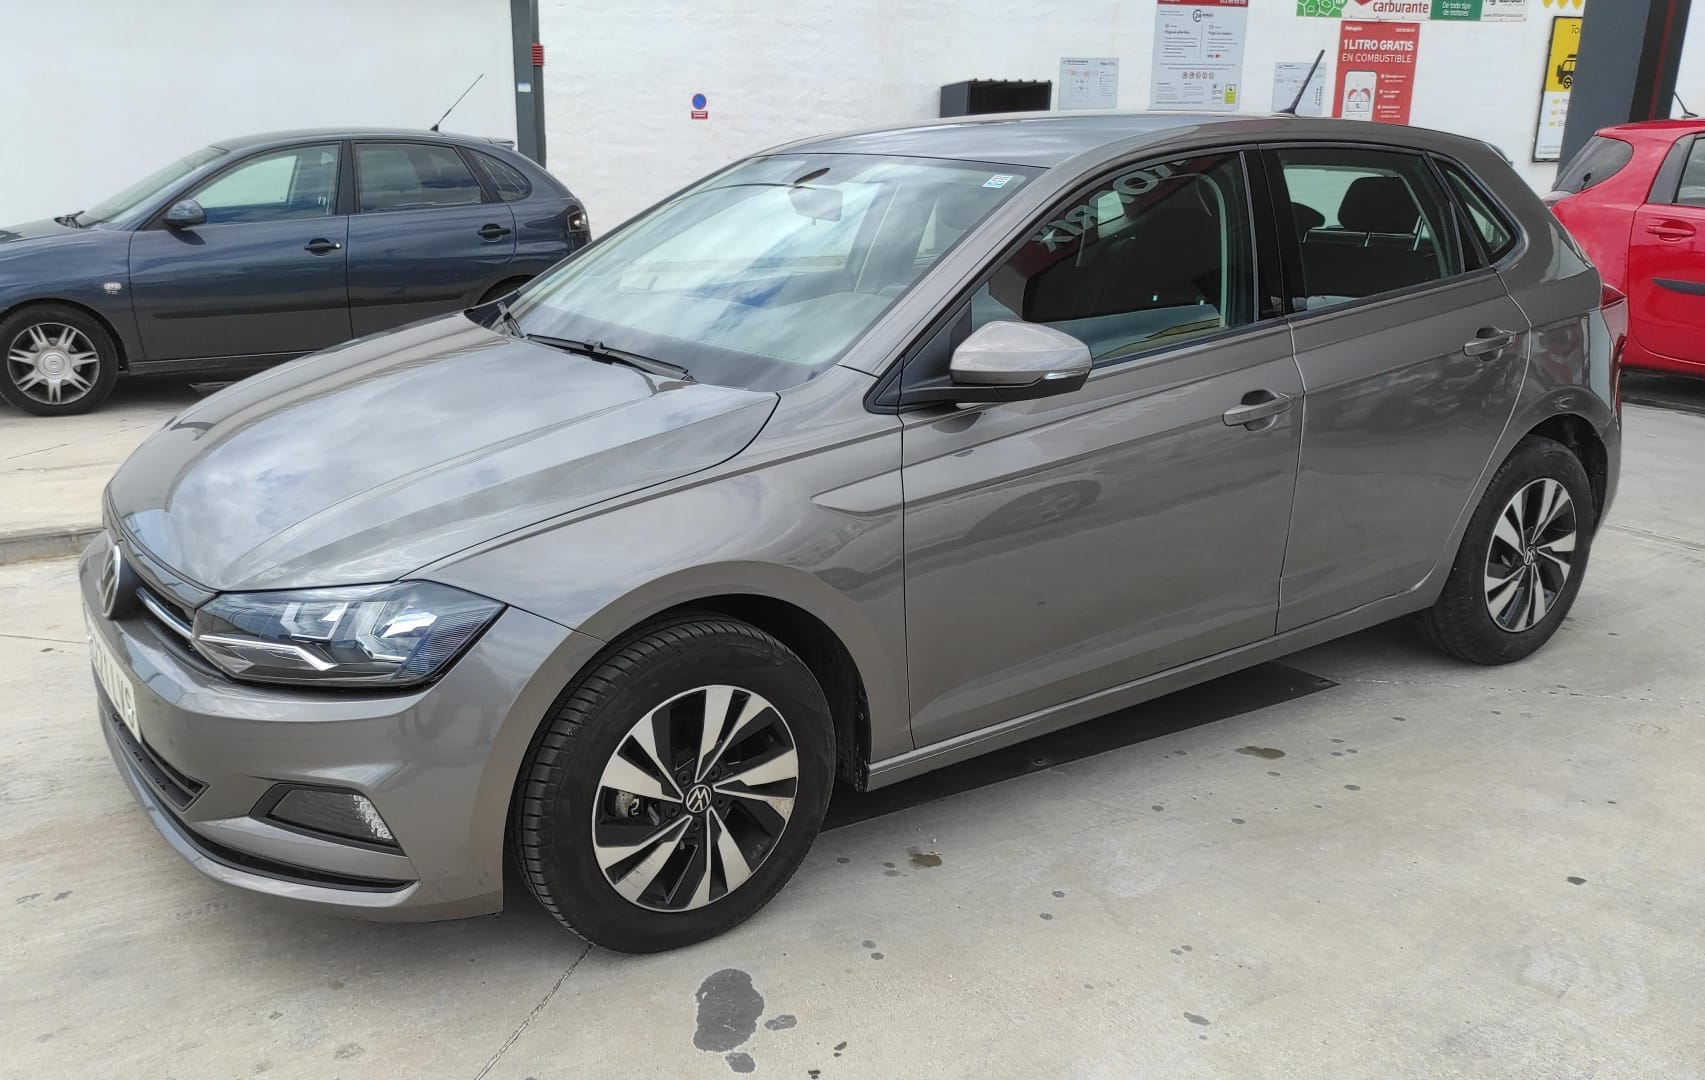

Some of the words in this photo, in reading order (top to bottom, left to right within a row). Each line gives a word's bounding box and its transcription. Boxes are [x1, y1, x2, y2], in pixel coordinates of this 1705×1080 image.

[1373, 0, 1429, 13] carburante
[1343, 39, 1348, 50] 1
[1349, 39, 1378, 51] LITRO
[1380, 40, 1414, 52] GRATIS
[1342, 53, 1353, 62] EN
[1355, 53, 1413, 63] COMBUSTIBLE
